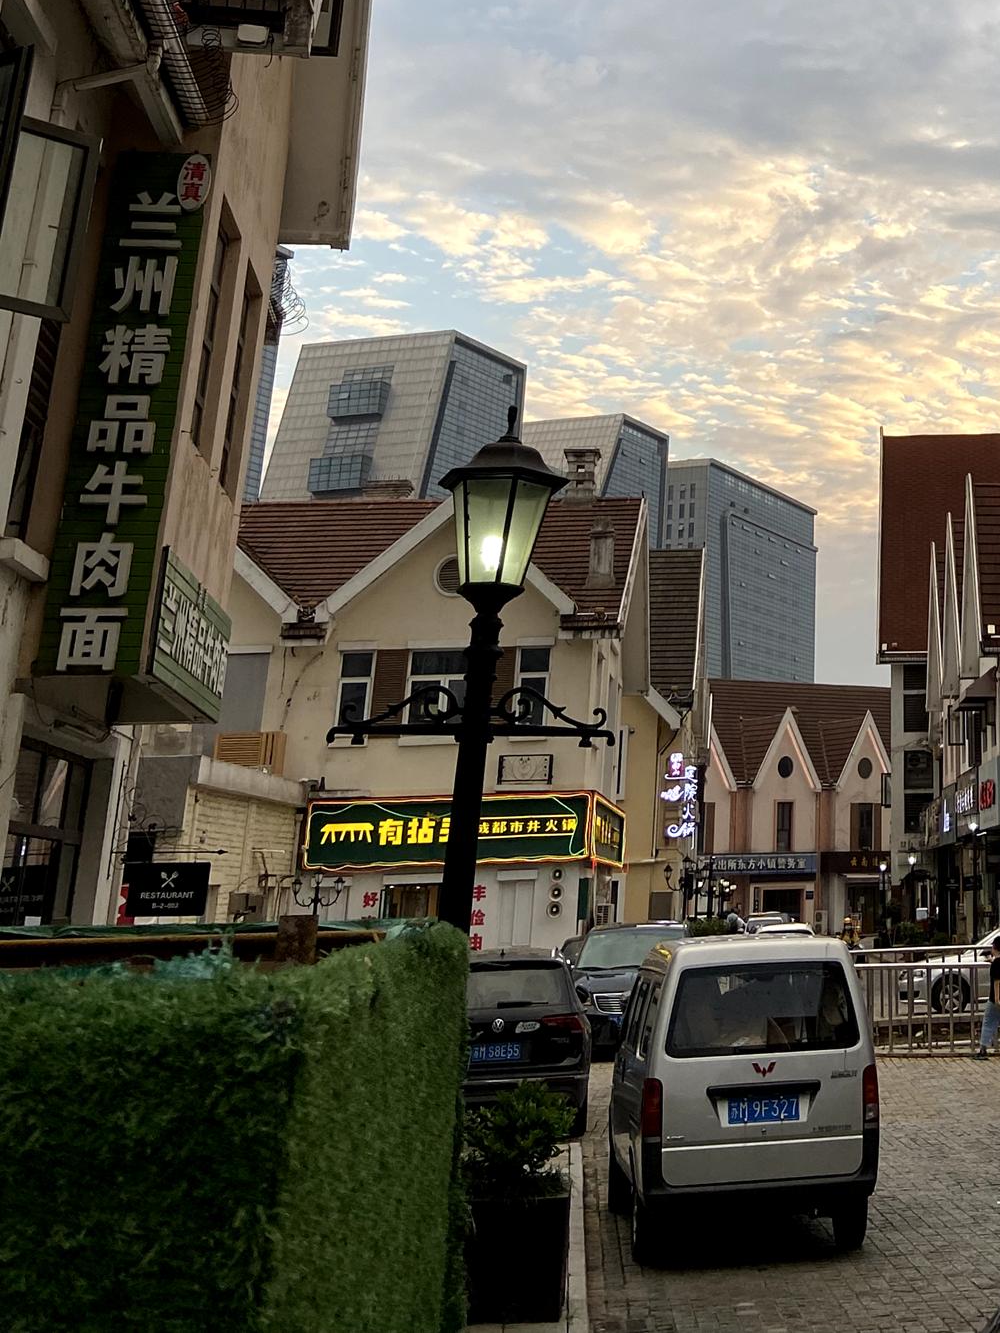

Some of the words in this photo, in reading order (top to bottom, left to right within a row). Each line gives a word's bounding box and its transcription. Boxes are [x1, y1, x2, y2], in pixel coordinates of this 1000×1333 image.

[181, 161, 208, 203] 清真
[56, 190, 183, 672] 兰州精品牛肉面
[157, 581, 231, 700] 兰州精品牛肉面
[140, 891, 194, 899] RESTAURANT
